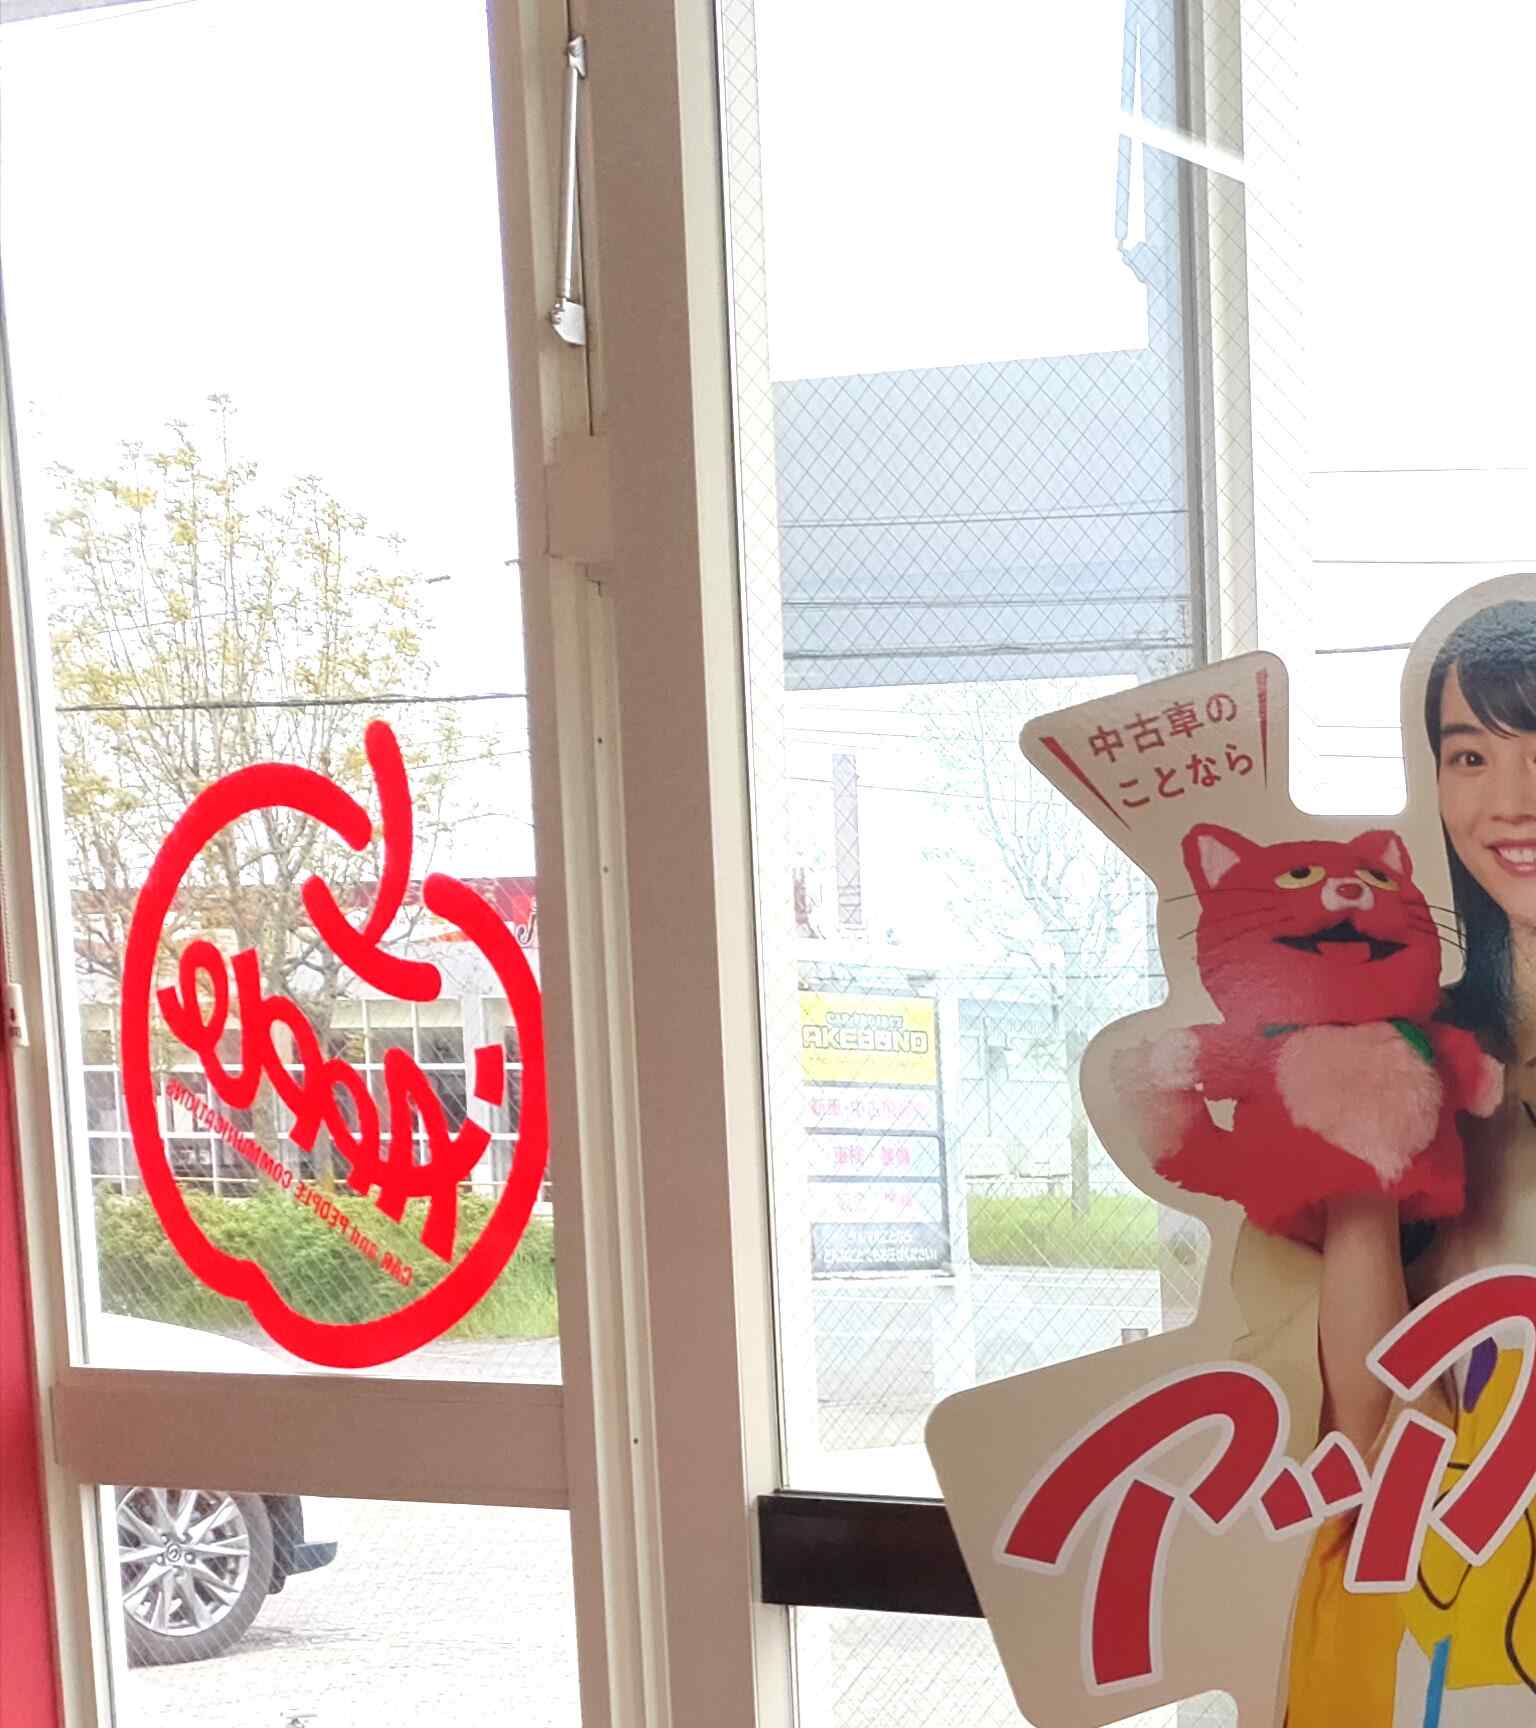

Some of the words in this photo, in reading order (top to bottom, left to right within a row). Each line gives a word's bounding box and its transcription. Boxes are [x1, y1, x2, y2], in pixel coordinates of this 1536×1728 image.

[1088, 693, 1240, 763] 中古車の
[1119, 743, 1255, 811] ことなら
